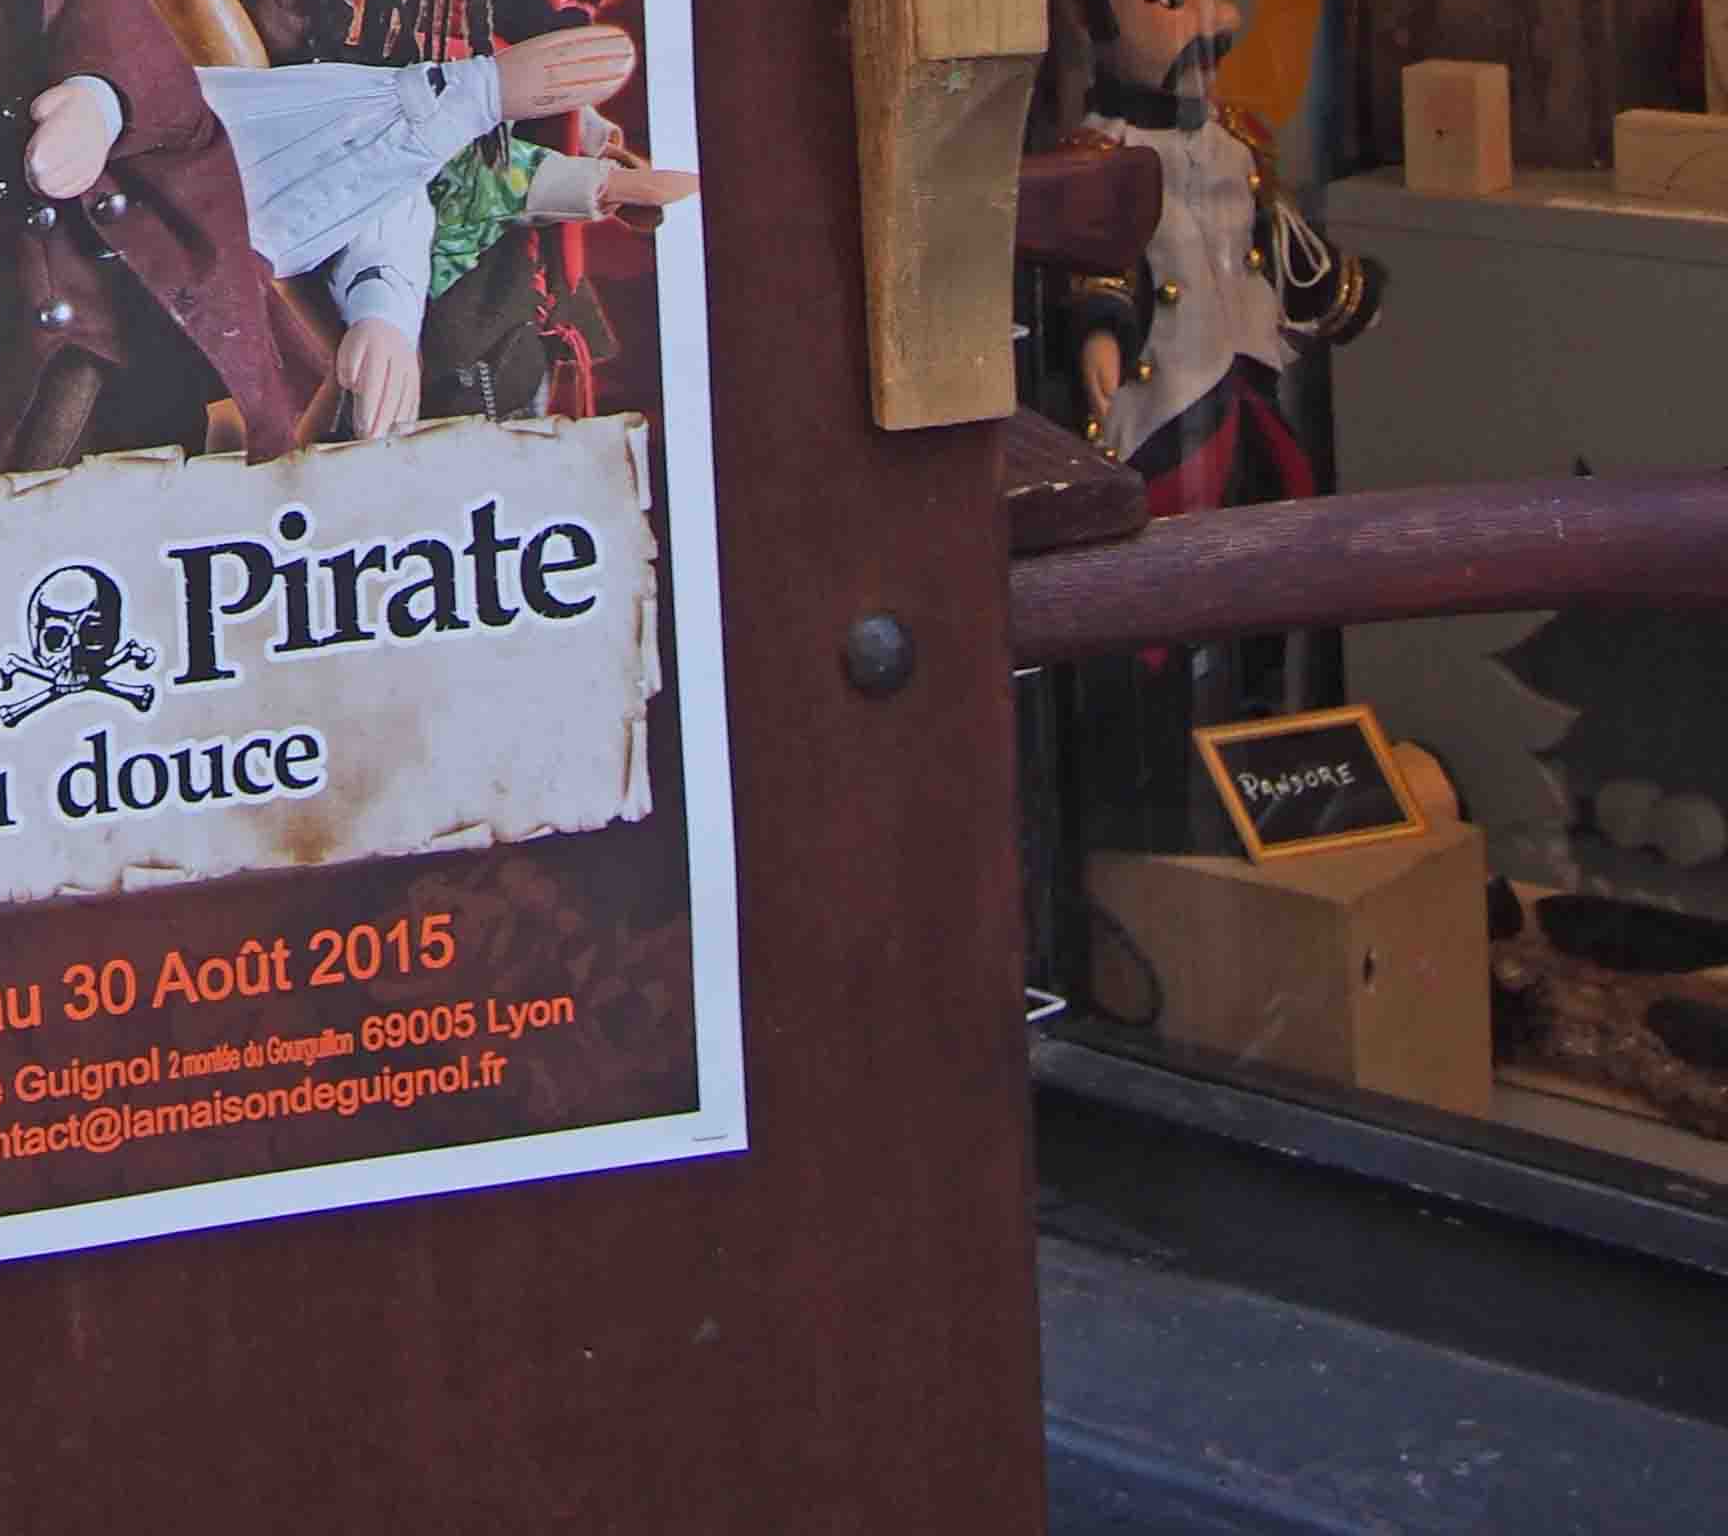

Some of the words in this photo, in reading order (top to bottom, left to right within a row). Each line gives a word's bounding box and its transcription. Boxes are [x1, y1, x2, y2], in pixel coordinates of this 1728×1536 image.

[167, 499, 600, 685] Pirate
[56, 730, 322, 818] douce
[62, 959, 136, 1022] 30
[152, 937, 291, 1009] Août
[307, 912, 456, 986] 2015
[14, 1046, 160, 1105] Guignol
[169, 1055, 180, 1078] 2
[244, 1039, 264, 1066] du
[361, 1001, 477, 1053] 69005
[486, 997, 574, 1038] Lyon
